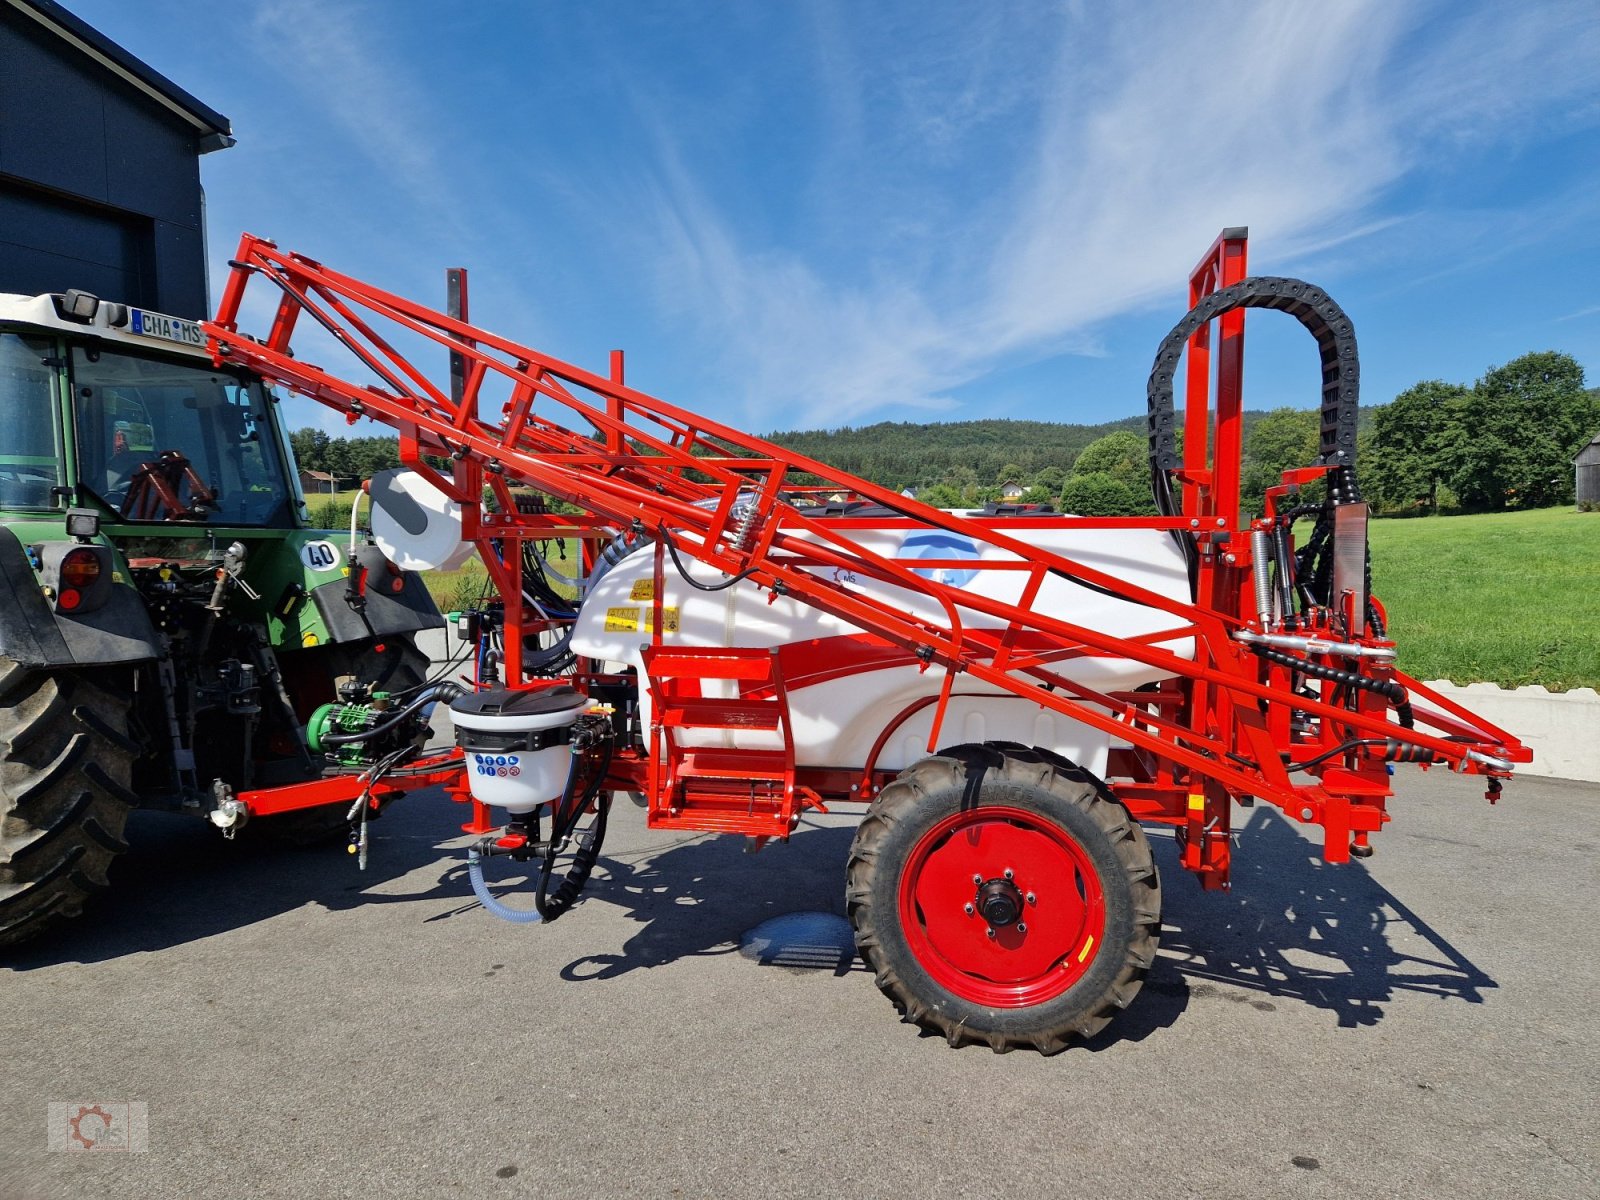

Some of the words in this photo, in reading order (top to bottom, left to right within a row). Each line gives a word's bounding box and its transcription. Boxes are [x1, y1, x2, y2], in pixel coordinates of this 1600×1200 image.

[142, 314, 172, 337] CHA
[182, 323, 201, 343] MS
[308, 544, 335, 567] 40
